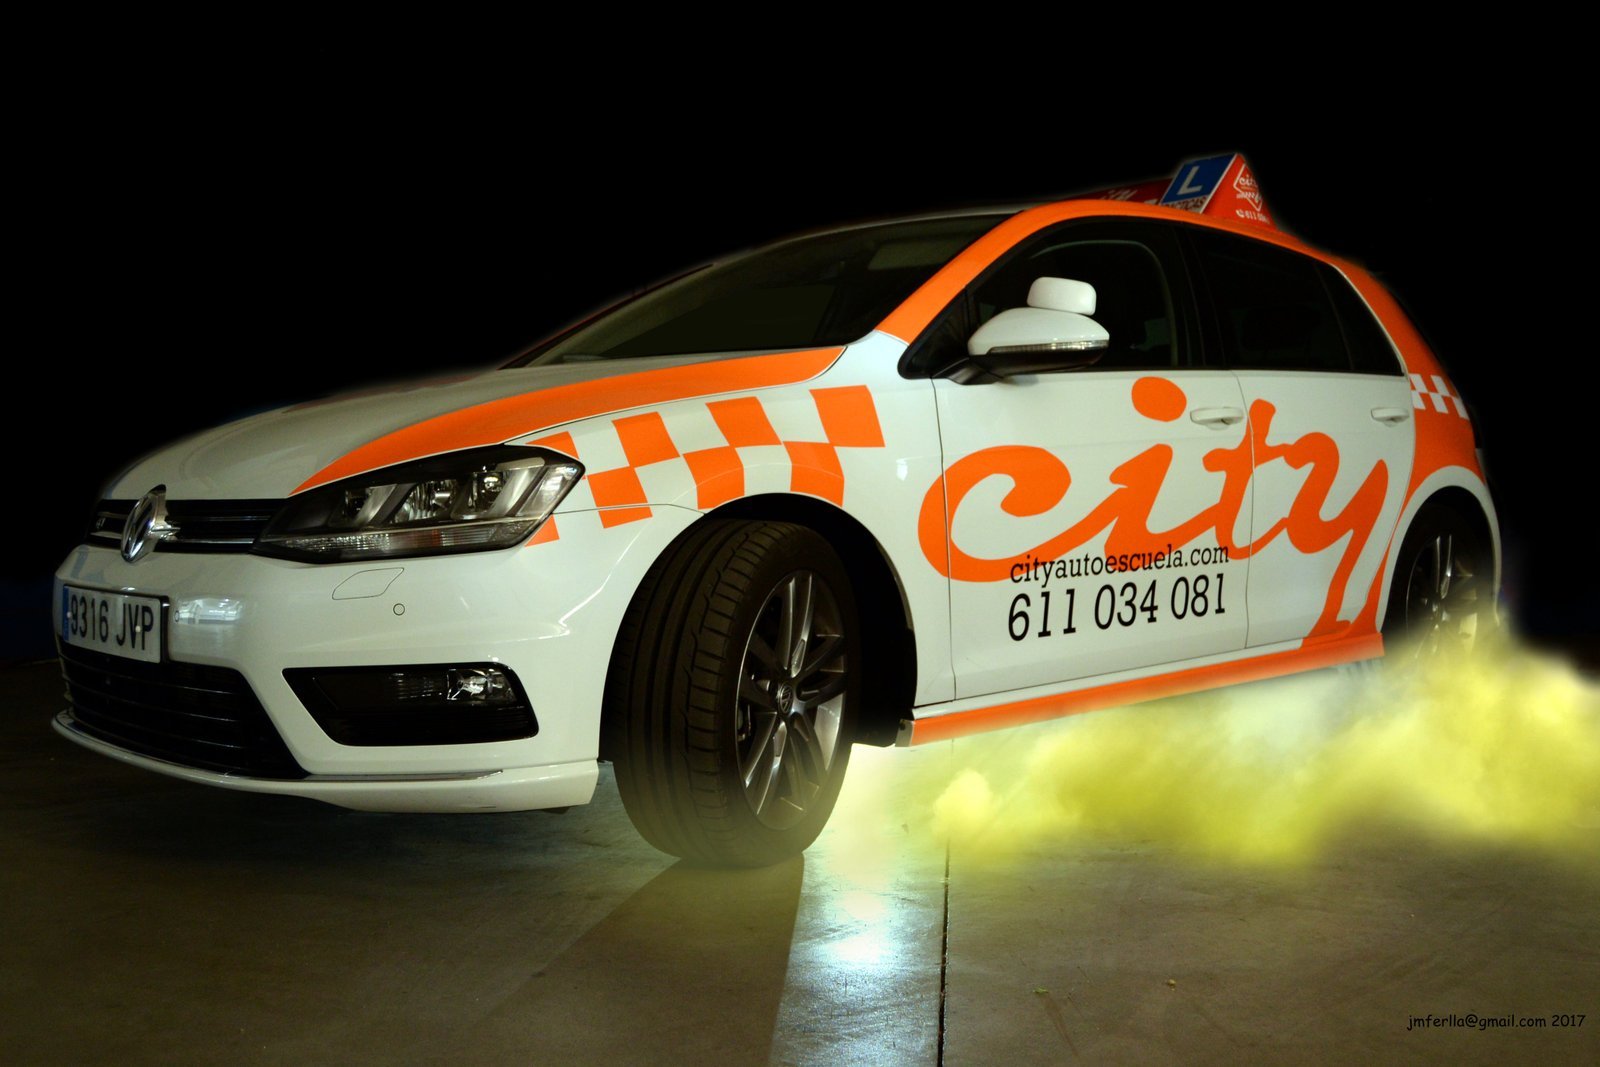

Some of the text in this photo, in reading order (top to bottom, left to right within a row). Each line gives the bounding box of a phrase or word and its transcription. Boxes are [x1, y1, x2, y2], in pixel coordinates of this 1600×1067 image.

[1177, 166, 1202, 195] L
[917, 377, 1388, 640] city
[1011, 544, 1230, 588] cityautoescuela.com
[71, 594, 154, 651] 9316 JVP
[1008, 574, 1226, 642] 611 034 081
